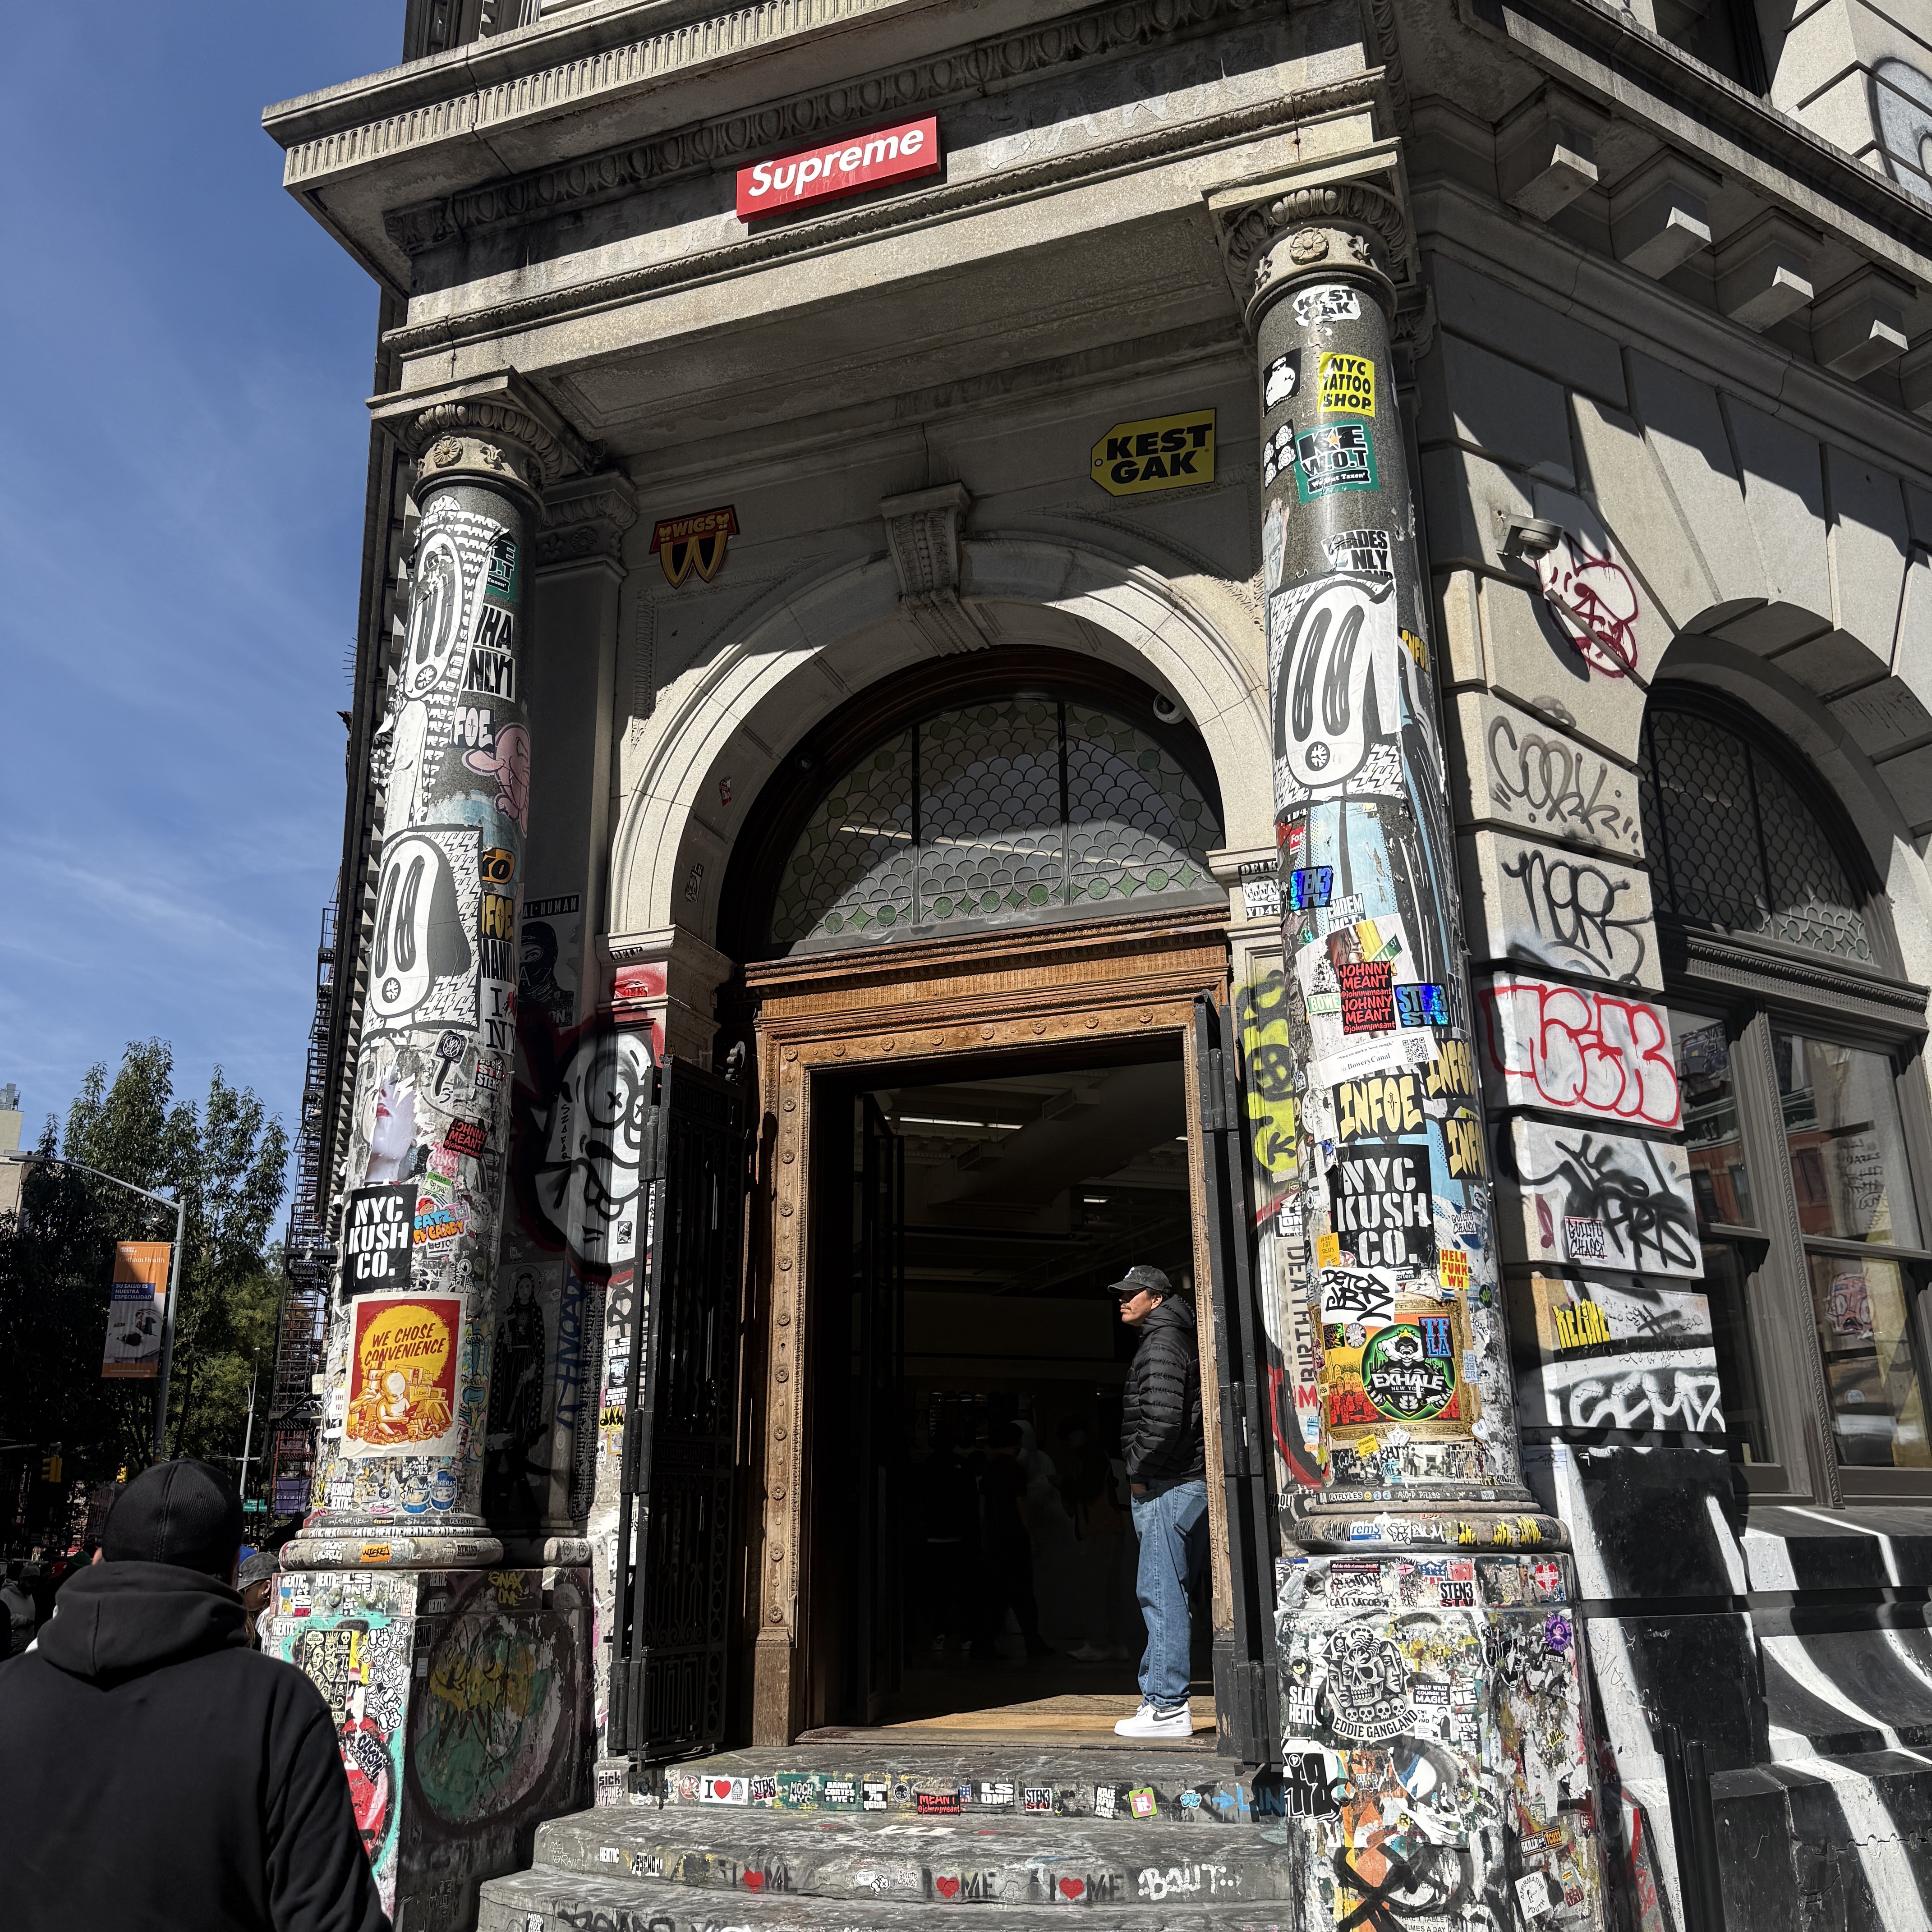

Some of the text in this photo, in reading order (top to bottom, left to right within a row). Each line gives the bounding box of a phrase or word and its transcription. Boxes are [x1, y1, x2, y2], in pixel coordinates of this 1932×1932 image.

[749, 130, 924, 196] Supreme
[1331, 358, 1366, 376] NYC
[1323, 375, 1371, 395] TATTOO
[1322, 393, 1371, 410] SHOP
[1107, 423, 1213, 461] KEST
[1111, 450, 1198, 484] GAK
[672, 515, 716, 537] WIGS
[541, 897, 577, 915] HUMAN
[1339, 962, 1390, 978] JOHNNY
[1343, 975, 1388, 990] MEANT
[1342, 996, 1393, 1012] JOHNNY
[1345, 1008, 1391, 1024] MEANT
[1343, 1020, 1395, 1034] @johnnymeant
[1339, 1075, 1423, 1141] INFOE
[451, 1120, 488, 1141] JOHNNY
[448, 1130, 484, 1151] MEANT
[1342, 1157, 1416, 1195] NYC
[354, 1196, 403, 1226] NYC
[414, 1209, 456, 1230] FATZ
[1336, 1193, 1431, 1232] KUSH
[348, 1223, 409, 1254] KUSH
[1357, 1230, 1418, 1267] CO.
[1441, 1249, 1467, 1263] HELM
[356, 1251, 396, 1279] CO.
[1442, 1262, 1468, 1276] FUNK
[1447, 1275, 1464, 1289] WH
[372, 1323, 436, 1349] WE CHOSE
[364, 1338, 447, 1365] CONVENIENCE
[1426, 1336, 1450, 1357] LA
[1372, 1373, 1445, 1391] EXHALE
[342, 1573, 373, 1584] LS
[1440, 1582, 1473, 1599] STEN3
[1416, 1695, 1448, 1704] MAGIC
[1334, 1710, 1418, 1739] EDDIE GANGLAND
[598, 1771, 621, 1786] sick
[827, 1781, 853, 1790] DANNY
[704, 1779, 714, 1799] I
[824, 1788, 856, 1797] CORTES
[981, 1782, 1014, 1795] LS
[1026, 1789, 1050, 1804] STEN3
[918, 1805, 961, 1815] @johnnymeant
[1086, 1874, 1126, 1901] ME
[1520, 1876, 1545, 1900] AFFIRMATIVE
[1527, 1898, 1545, 1914] YOUTH
[1423, 1915, 1449, 1923] TABLET
